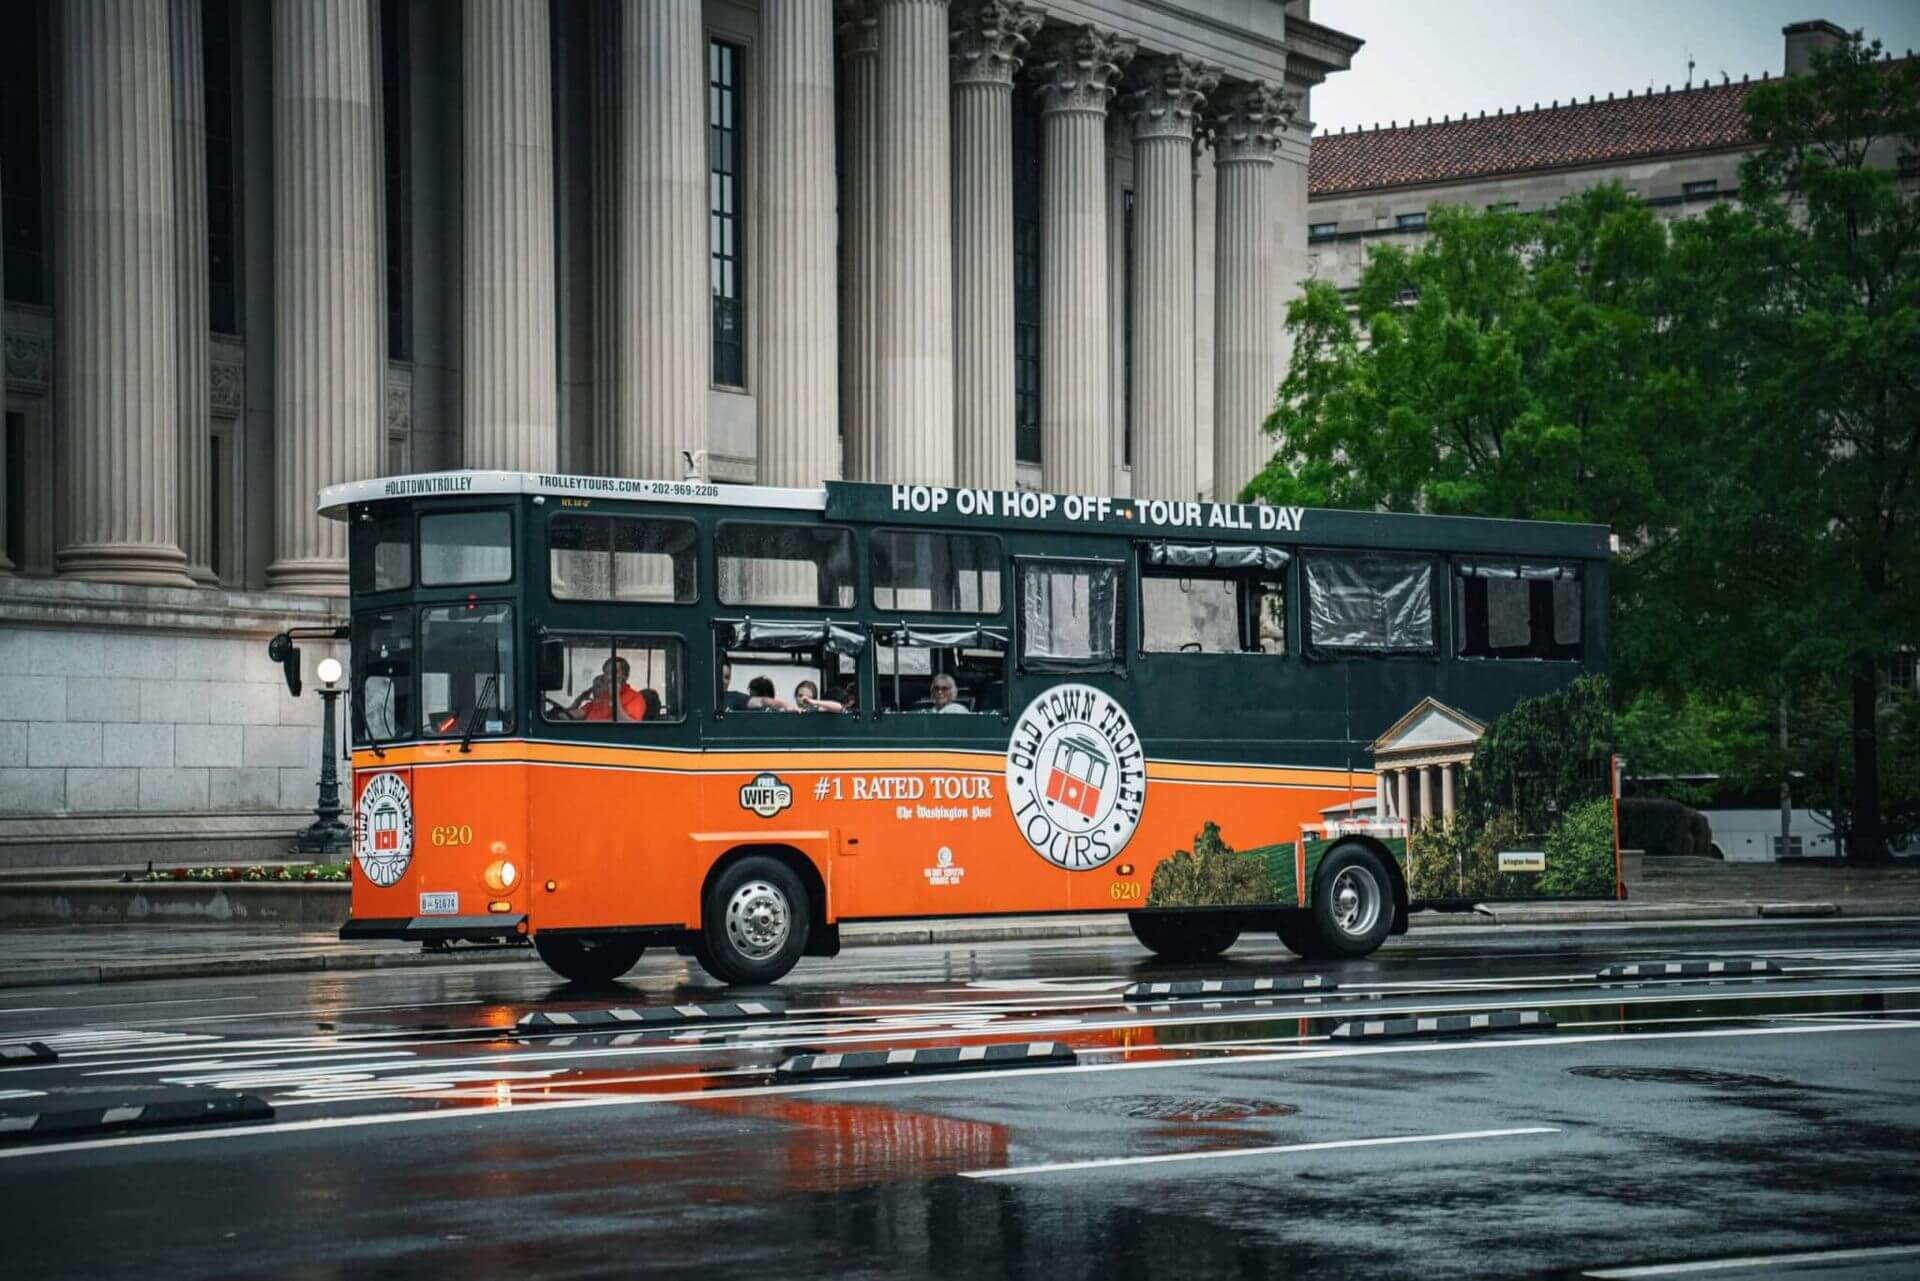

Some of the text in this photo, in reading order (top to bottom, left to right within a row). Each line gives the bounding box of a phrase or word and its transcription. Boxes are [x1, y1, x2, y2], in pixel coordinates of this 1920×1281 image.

[385, 476, 472, 496] #OLDTOWNTROLLEY
[538, 475, 719, 497] TROLLEYTOURS.COM 202-969-2206
[892, 484, 948, 513] HOP
[956, 488, 994, 515] ON
[1002, 490, 1056, 518] HOP
[1063, 494, 1112, 521] OFF
[1134, 499, 1202, 527] TOUR
[1208, 503, 1253, 530] ALL
[1259, 505, 1304, 532] DAY
[1011, 688, 1144, 824] OLD TOWN TROLLEY
[744, 789, 774, 805] WIFI
[813, 776, 993, 801] #1 RATED TOUR
[896, 804, 993, 822] The Washington Post
[431, 825, 473, 847] 620
[1015, 789, 1112, 867] TOURS
[363, 852, 408, 885] TOURS
[1110, 881, 1141, 901] 620
